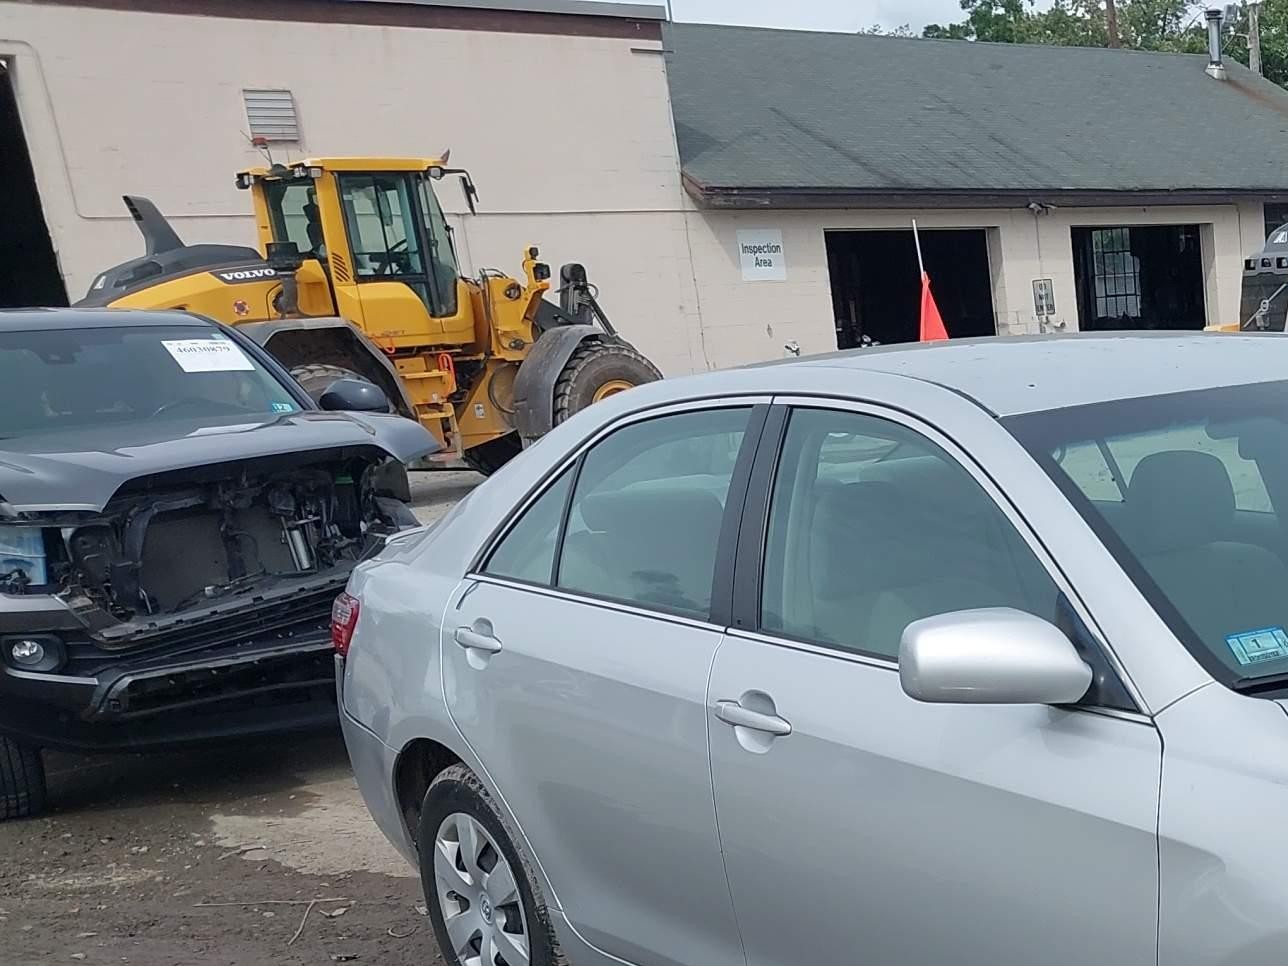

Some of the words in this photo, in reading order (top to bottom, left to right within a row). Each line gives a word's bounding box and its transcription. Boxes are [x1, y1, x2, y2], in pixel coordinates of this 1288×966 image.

[741, 243, 782, 255] Inspection
[755, 257, 772, 267] Area
[220, 268, 276, 281] VOLVO
